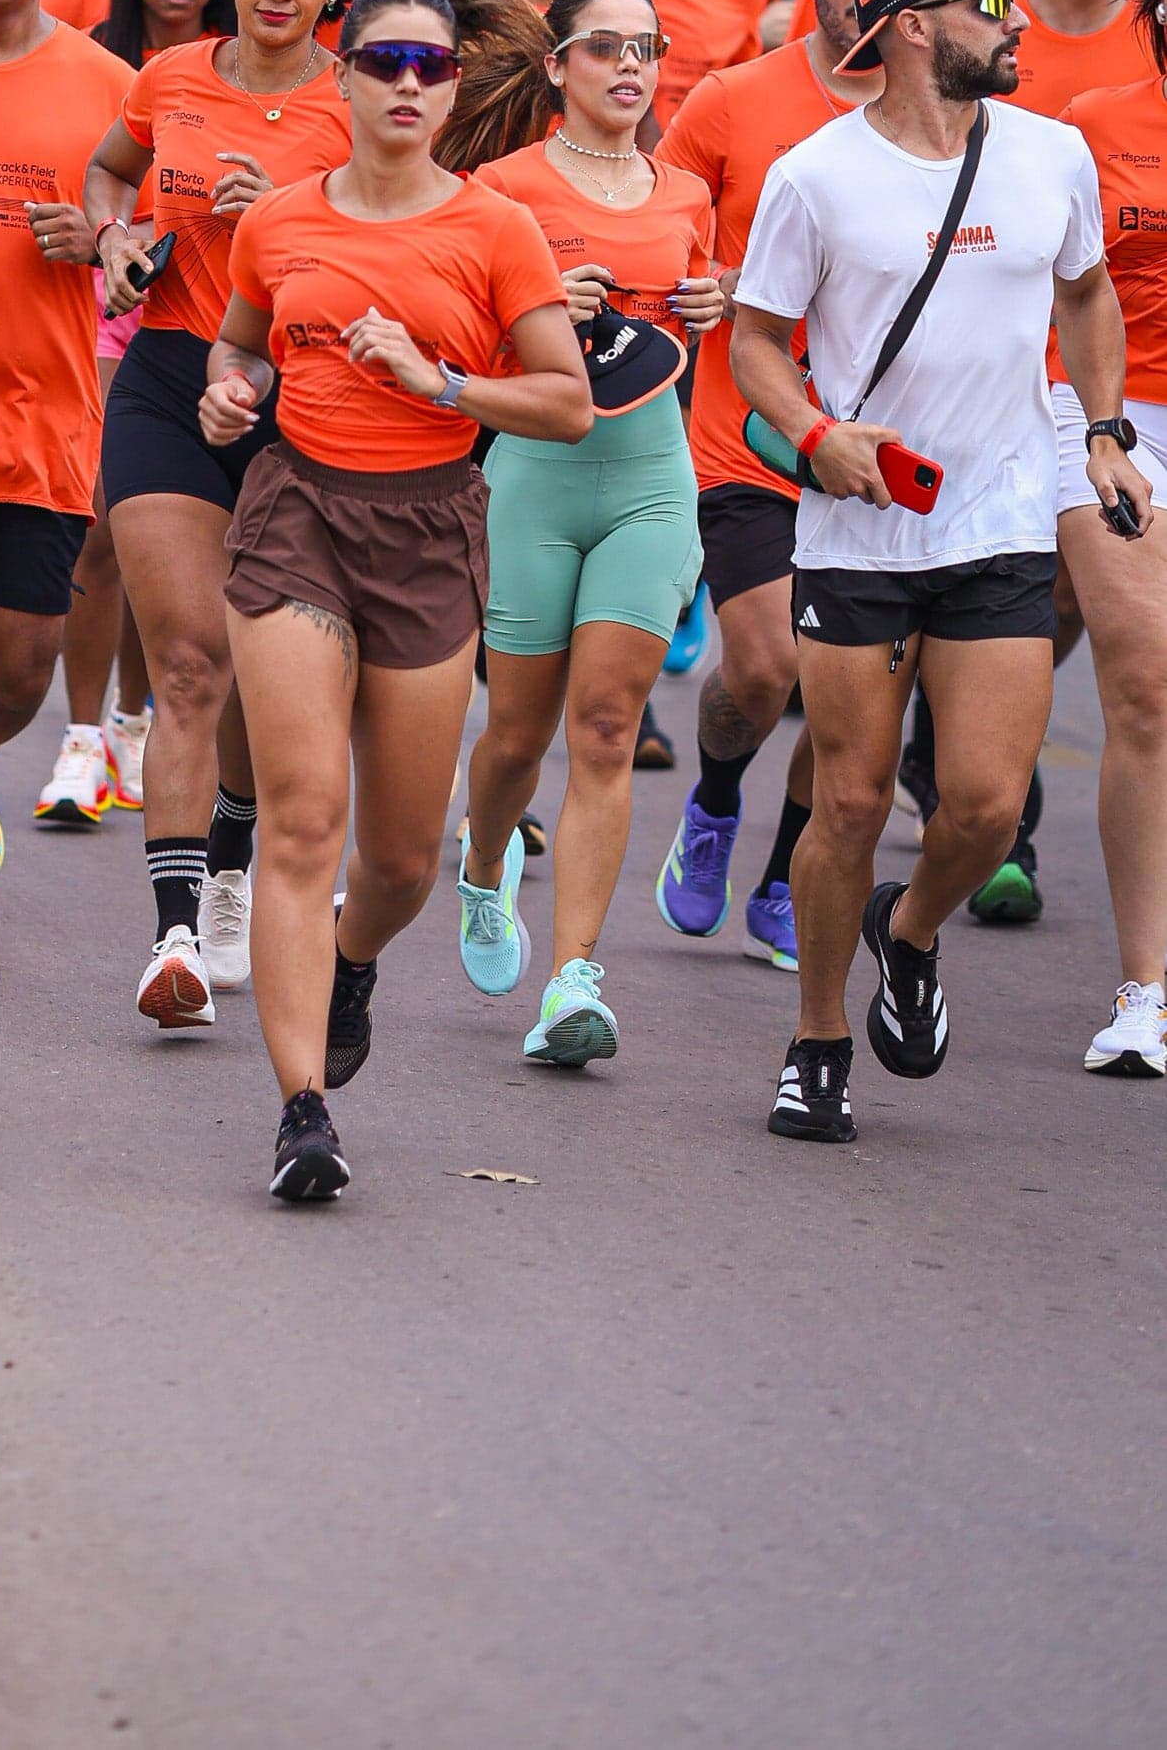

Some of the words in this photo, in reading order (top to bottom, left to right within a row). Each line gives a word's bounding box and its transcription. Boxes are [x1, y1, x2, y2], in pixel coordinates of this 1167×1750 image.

[1121, 153, 1160, 163] tfsports
[175, 170, 204, 185] Porto
[175, 184, 208, 199] Saúde
[548, 238, 585, 249] fsports
[927, 226, 996, 249] SMMA
[970, 244, 997, 253] CLUB
[596, 325, 638, 363] SOMMA
